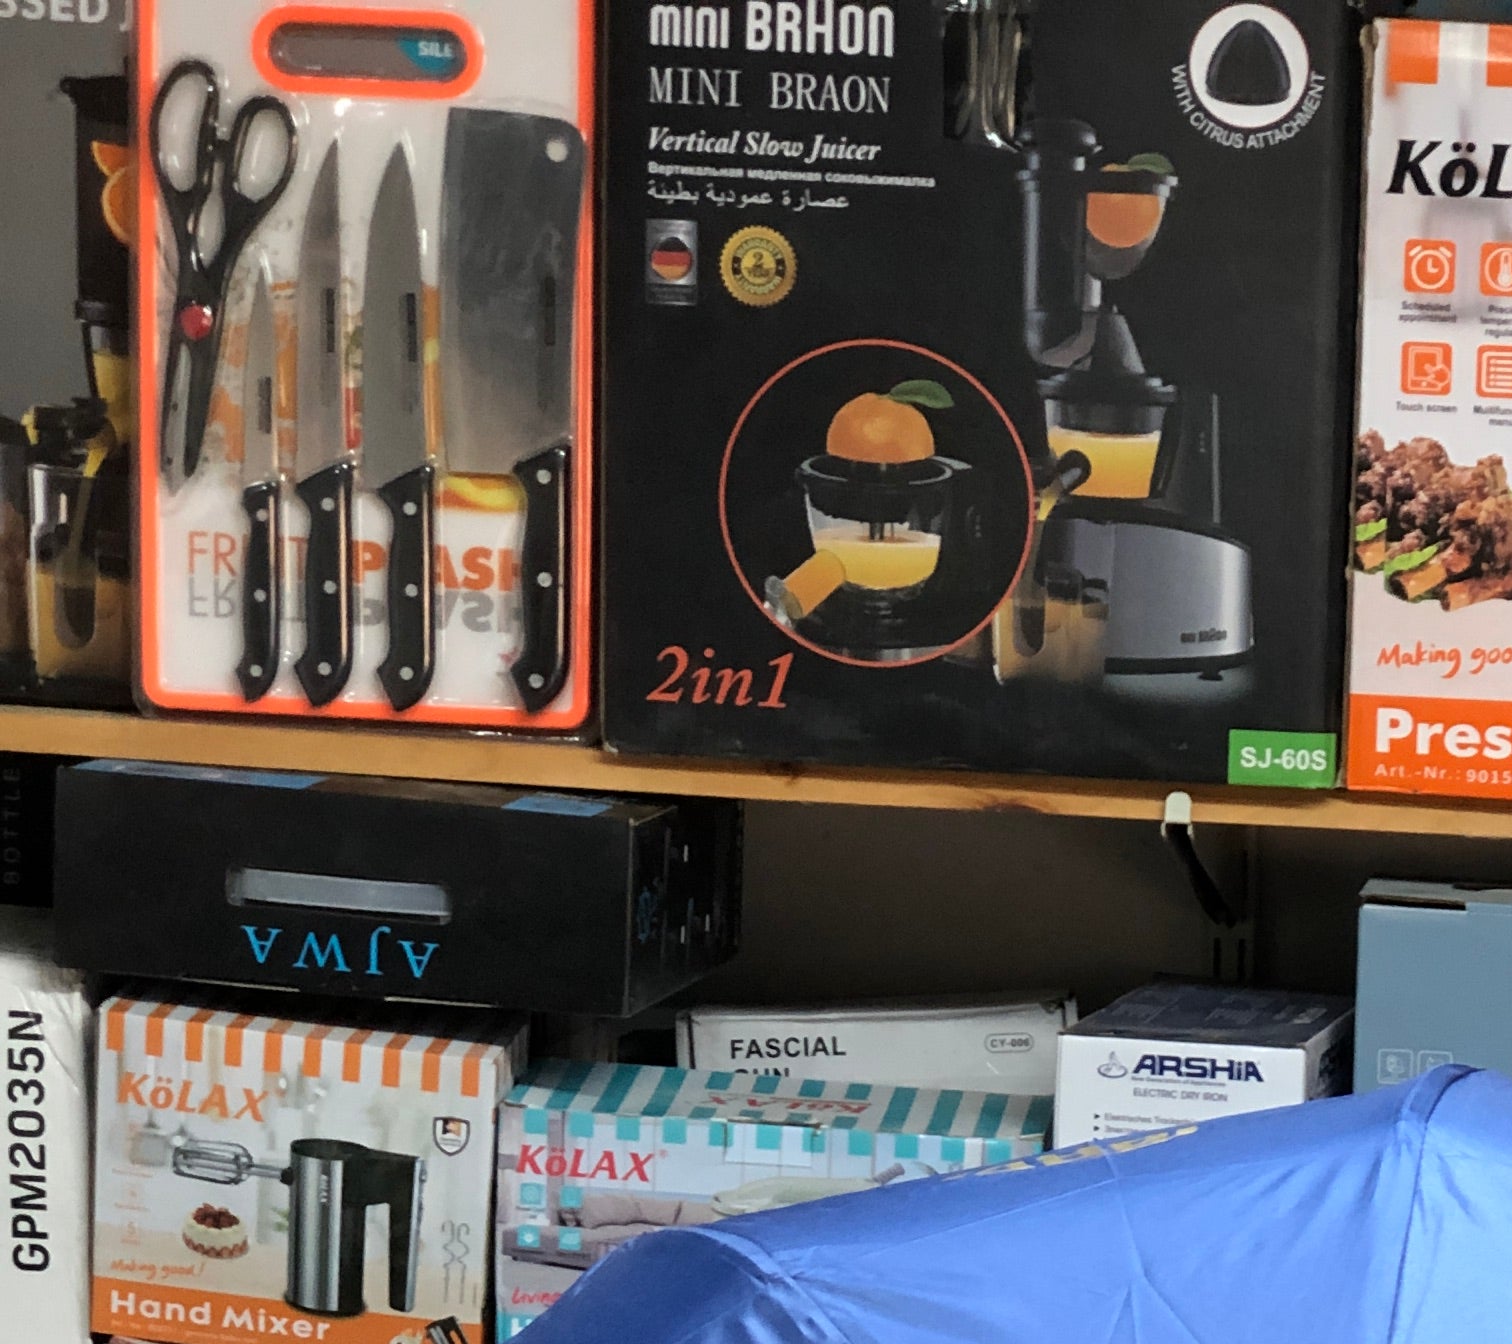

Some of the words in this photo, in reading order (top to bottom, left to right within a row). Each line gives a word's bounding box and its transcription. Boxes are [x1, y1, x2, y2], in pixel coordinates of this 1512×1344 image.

[649, 66, 743, 107] MINI
[768, 71, 891, 114] BRAON
[1171, 64, 1196, 114] WITH
[1189, 111, 1245, 149] CITRUS
[1246, 70, 1327, 150] ATTACHMENT
[649, 126, 741, 155] Vertical
[743, 131, 804, 157] Slow
[804, 133, 882, 165] Juicer
[645, 644, 795, 710] 2in1
[1376, 642, 1462, 680] Making
[1239, 745, 1328, 772] SJ-60S
[239, 924, 440, 979] AJWA
[730, 1036, 847, 1060] FASCIAL
[1132, 1086, 1178, 1100] ELECTRIC
[1180, 1089, 1201, 1101] DRY
[1202, 1091, 1228, 1103] IRON
[7, 1009, 51, 1272] GPM2035N
[110, 1288, 213, 1327] Hand
[220, 1304, 332, 1341] Mixer
